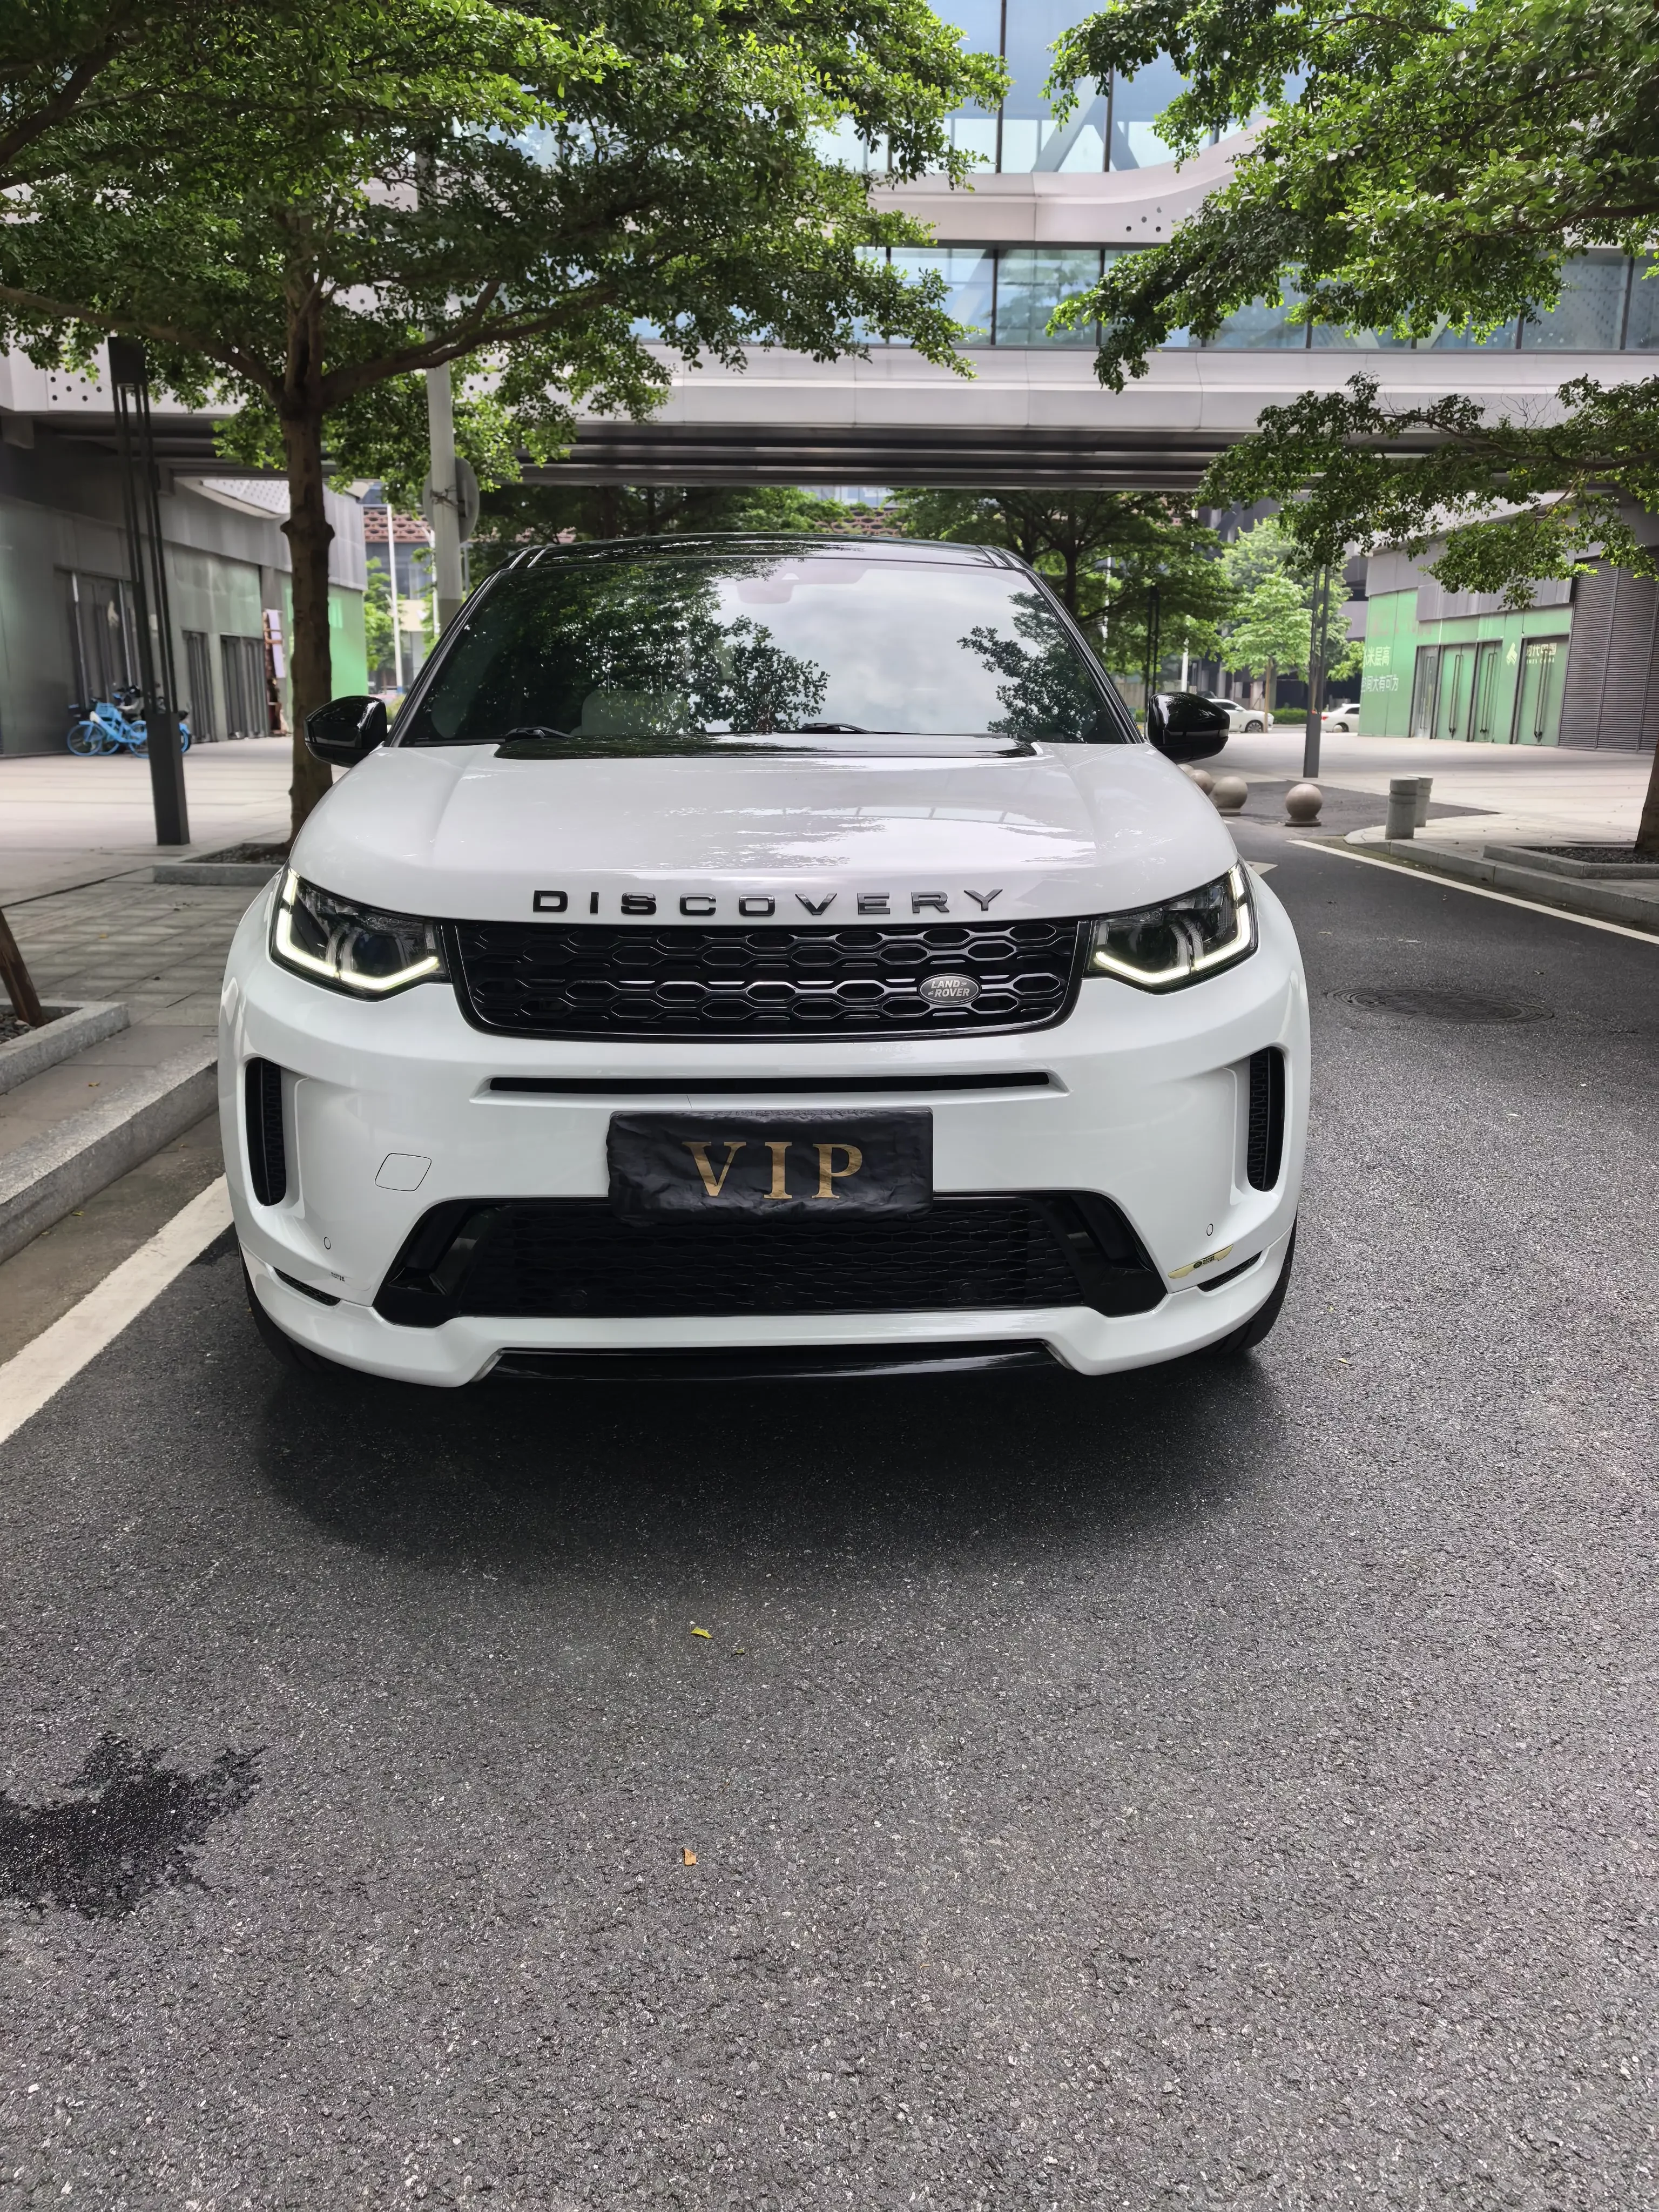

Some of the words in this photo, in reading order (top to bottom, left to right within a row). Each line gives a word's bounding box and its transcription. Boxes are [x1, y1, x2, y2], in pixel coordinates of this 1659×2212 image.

[532, 889, 1003, 916] DISCOVERY
[931, 980, 960, 988] LAND
[934, 988, 970, 997] ROVER
[682, 1142, 863, 1199] VIP
